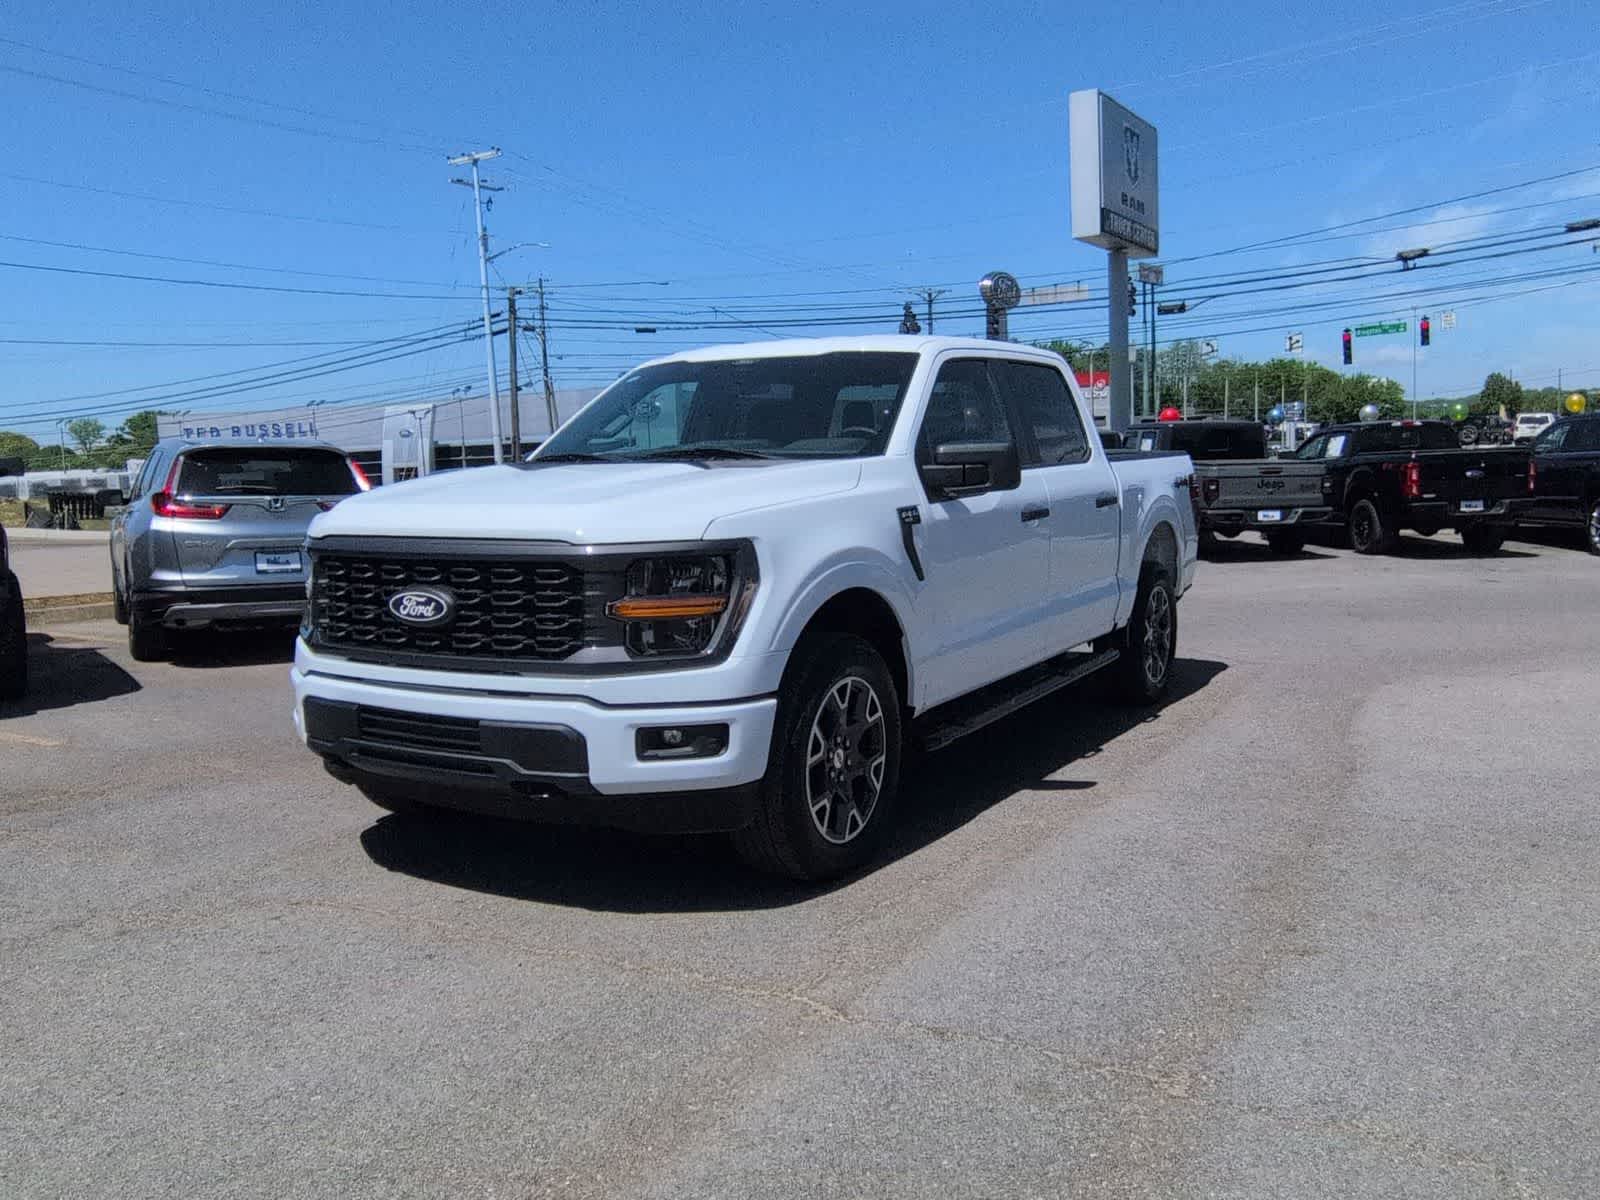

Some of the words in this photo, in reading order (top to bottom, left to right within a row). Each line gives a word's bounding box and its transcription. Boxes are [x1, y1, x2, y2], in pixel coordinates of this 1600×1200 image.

[1121, 192, 1145, 215] RAM
[231, 422, 319, 439] RUSSELL
[1257, 479, 1285, 491] Jeep
[399, 595, 437, 617] Ford
